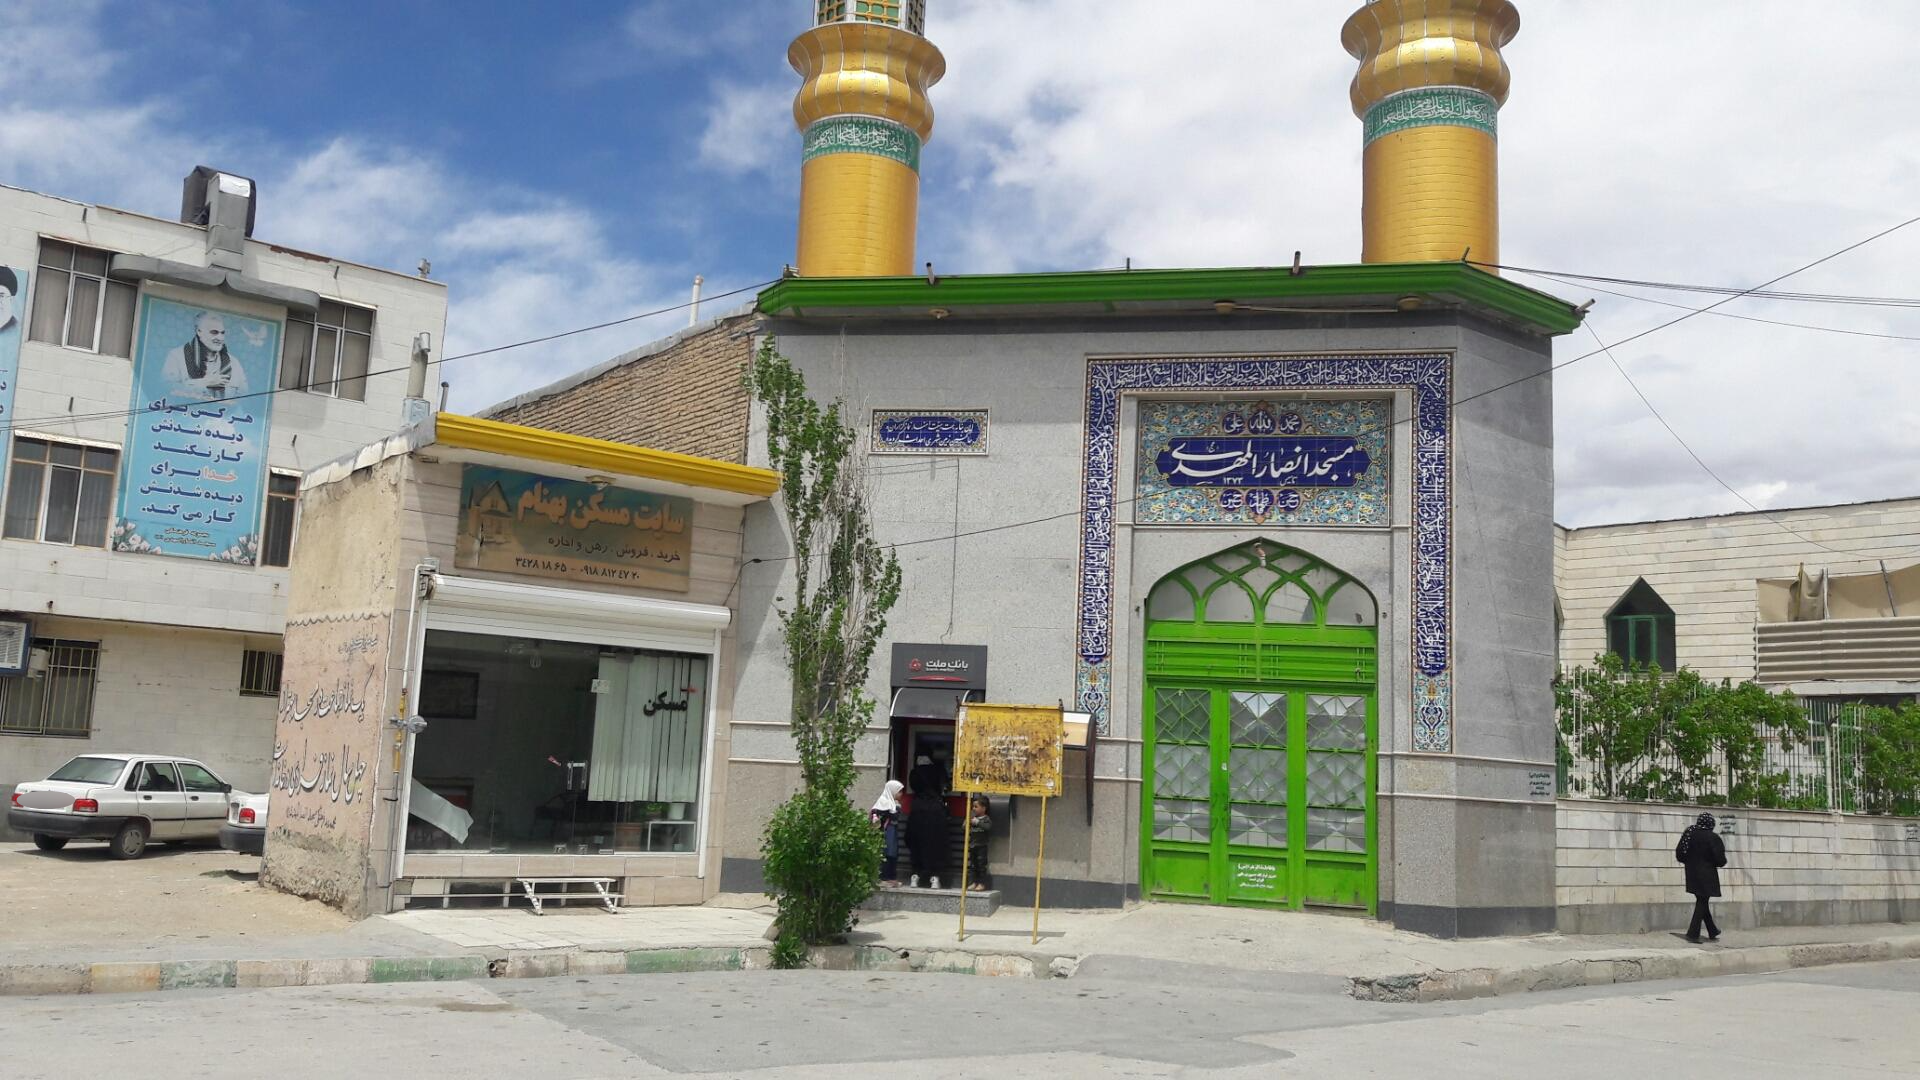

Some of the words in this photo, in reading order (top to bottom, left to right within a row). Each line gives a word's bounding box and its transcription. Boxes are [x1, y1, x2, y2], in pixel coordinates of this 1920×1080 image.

[149, 398, 188, 416] برای
[190, 408, 225, 418] کس
[228, 414, 253, 424] هر
[151, 420, 202, 435] شدنش
[205, 429, 244, 444] دیده
[153, 441, 212, 458] نکند
[214, 449, 244, 463] کار
[151, 461, 201, 480] برای
[1306, 445, 1355, 482] مسجد
[202, 466, 237, 481] خدا
[140, 481, 202, 497] شدنش
[204, 490, 243, 505] دیده
[518, 481, 567, 525] بهنام
[182, 512, 203, 521] می
[205, 510, 235, 524] کار
[569, 492, 630, 530] مسکن
[633, 501, 684, 537] سایت
[548, 536, 574, 548] اجاره
[576, 542, 582, 551] و
[585, 543, 608, 554] رهن
[616, 544, 649, 558] فروش
[656, 551, 681, 562] خرید
[926, 659, 948, 668] ملت
[948, 659, 969, 672] بانک
[643, 690, 688, 717] مسکن
